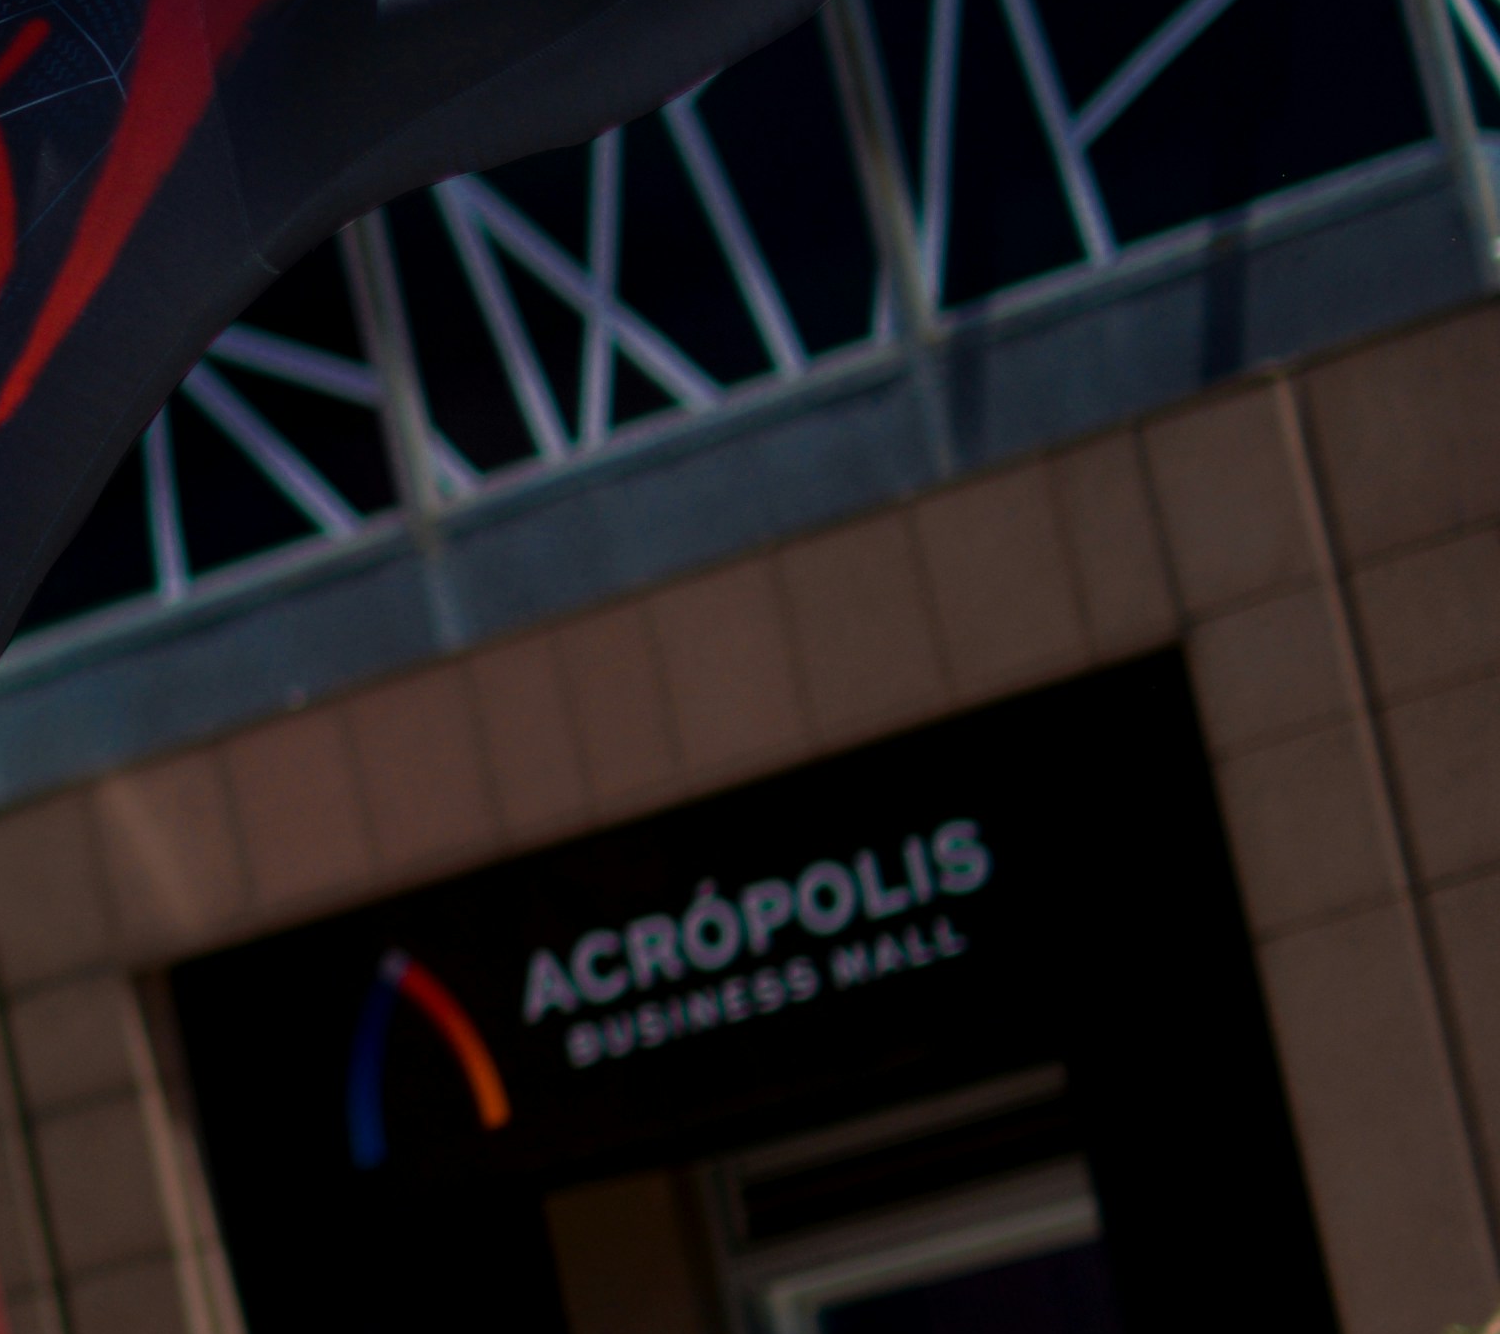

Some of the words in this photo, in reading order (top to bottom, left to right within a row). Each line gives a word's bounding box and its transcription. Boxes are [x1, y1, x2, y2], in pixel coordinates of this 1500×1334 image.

[523, 818, 992, 1025] ACRÓPOLIS
[566, 957, 822, 1068] BUSINESS
[830, 916, 968, 989] MALL
